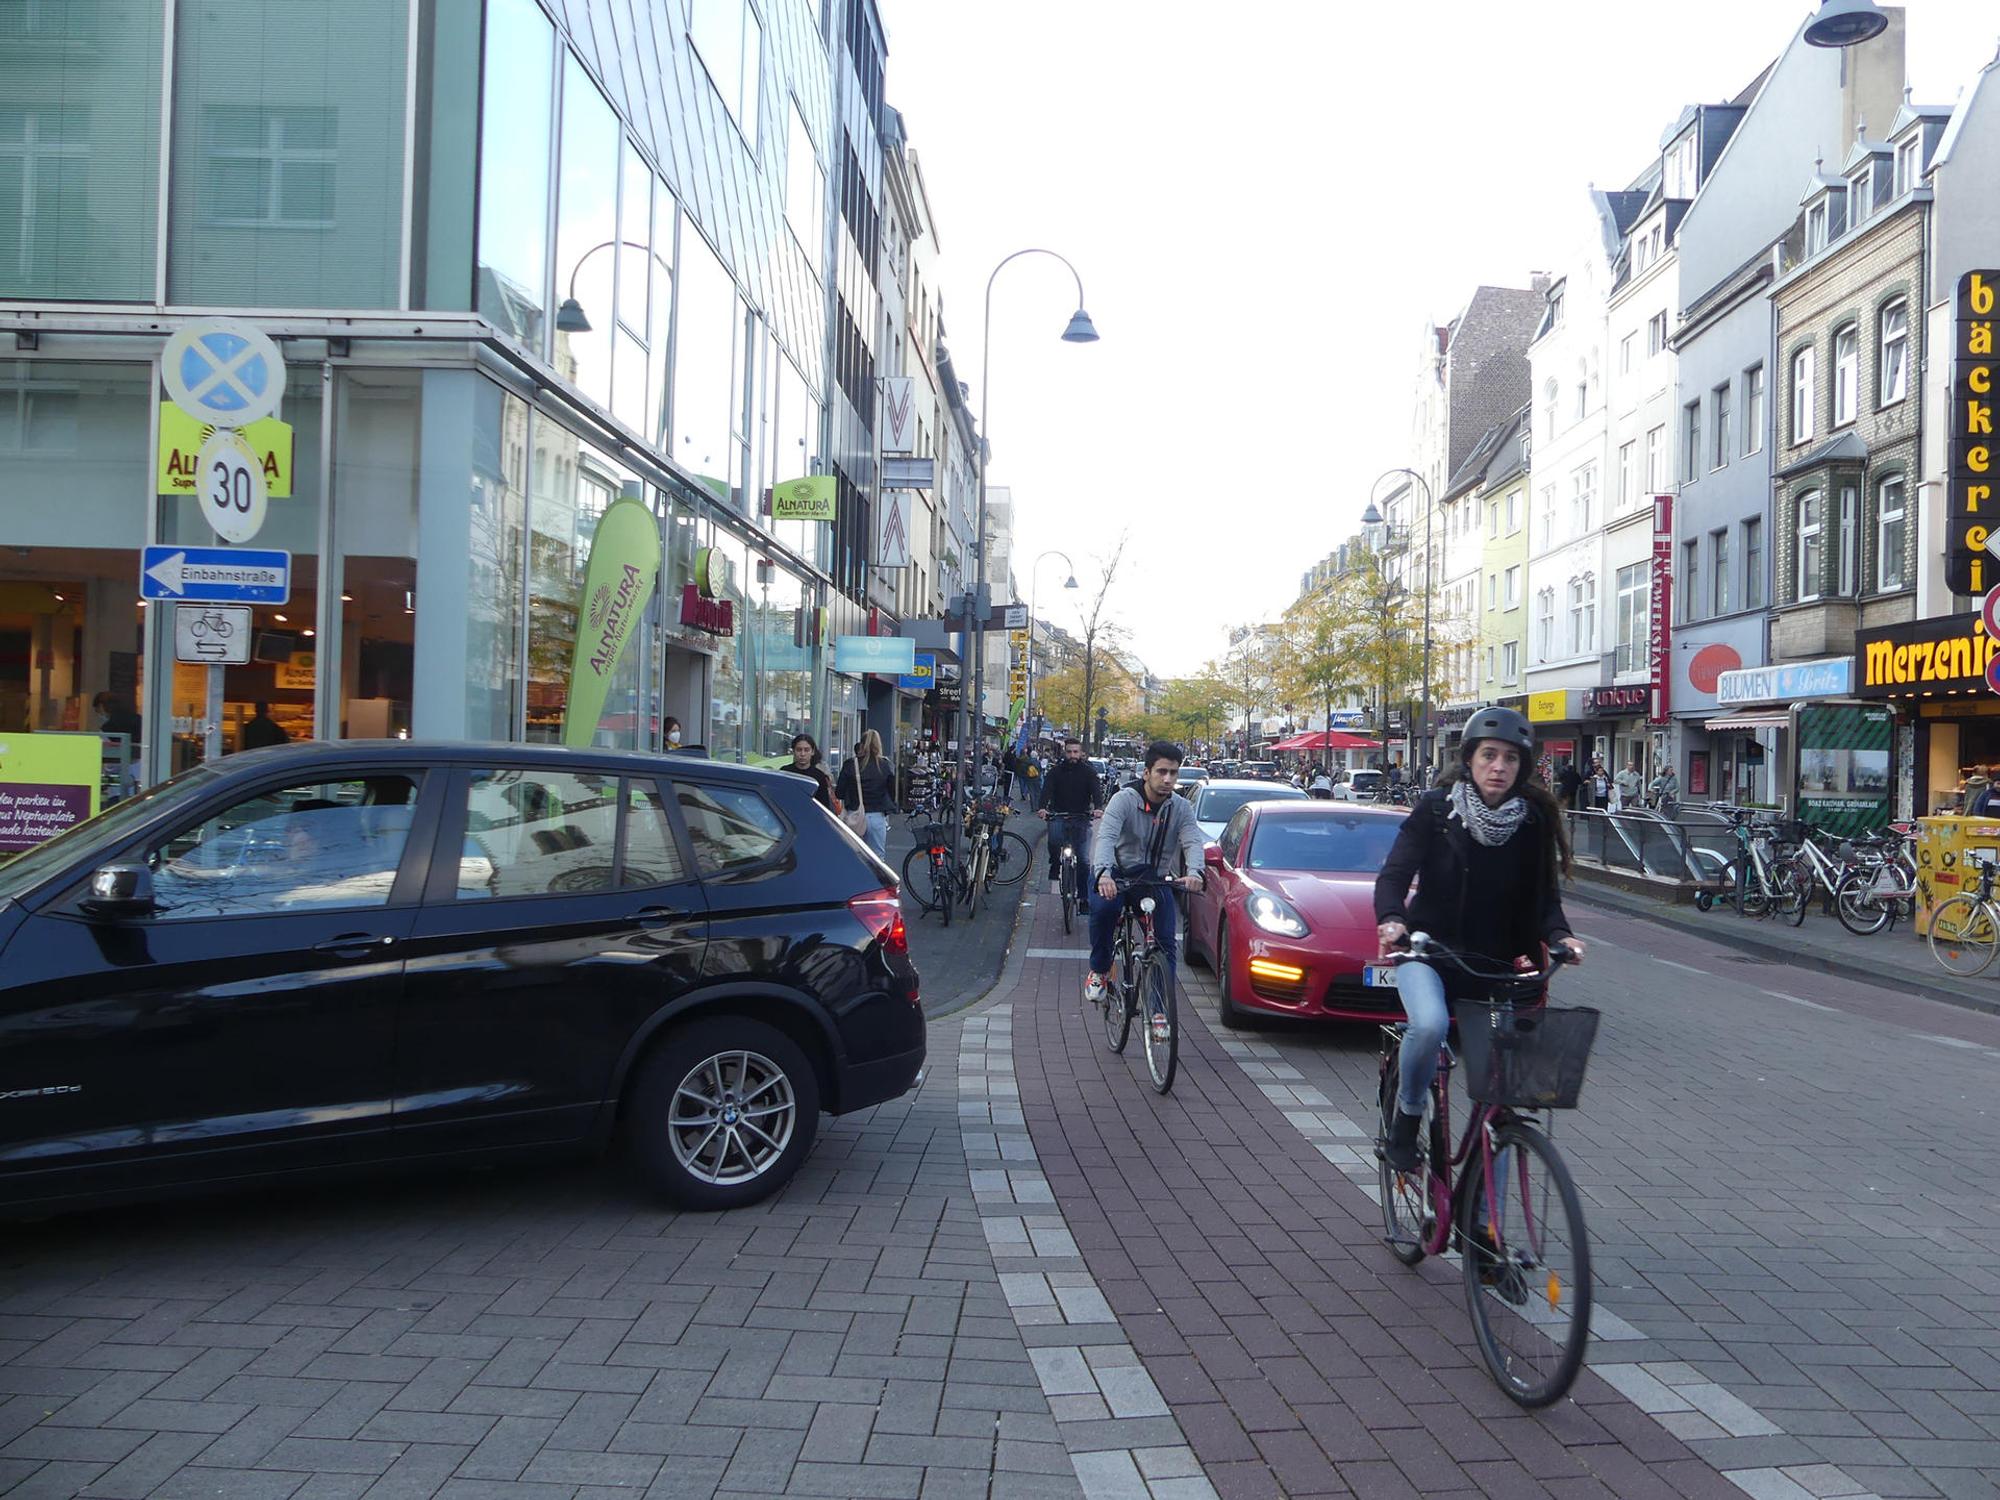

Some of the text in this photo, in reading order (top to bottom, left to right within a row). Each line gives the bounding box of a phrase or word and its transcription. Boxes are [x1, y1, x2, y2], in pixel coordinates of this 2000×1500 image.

[1965, 274, 1994, 591] bäckerei
[213, 461, 251, 513] 30
[776, 496, 830, 511] ALNATURA
[181, 567, 276, 583] Einbahnstraße
[591, 563, 640, 676] ALNATURA
[912, 665, 932, 677] EDi
[1720, 672, 1771, 701] BLUMEN
[1596, 687, 1646, 709] unique
[14, 794, 50, 809] parken
[1378, 969, 1389, 985] K
